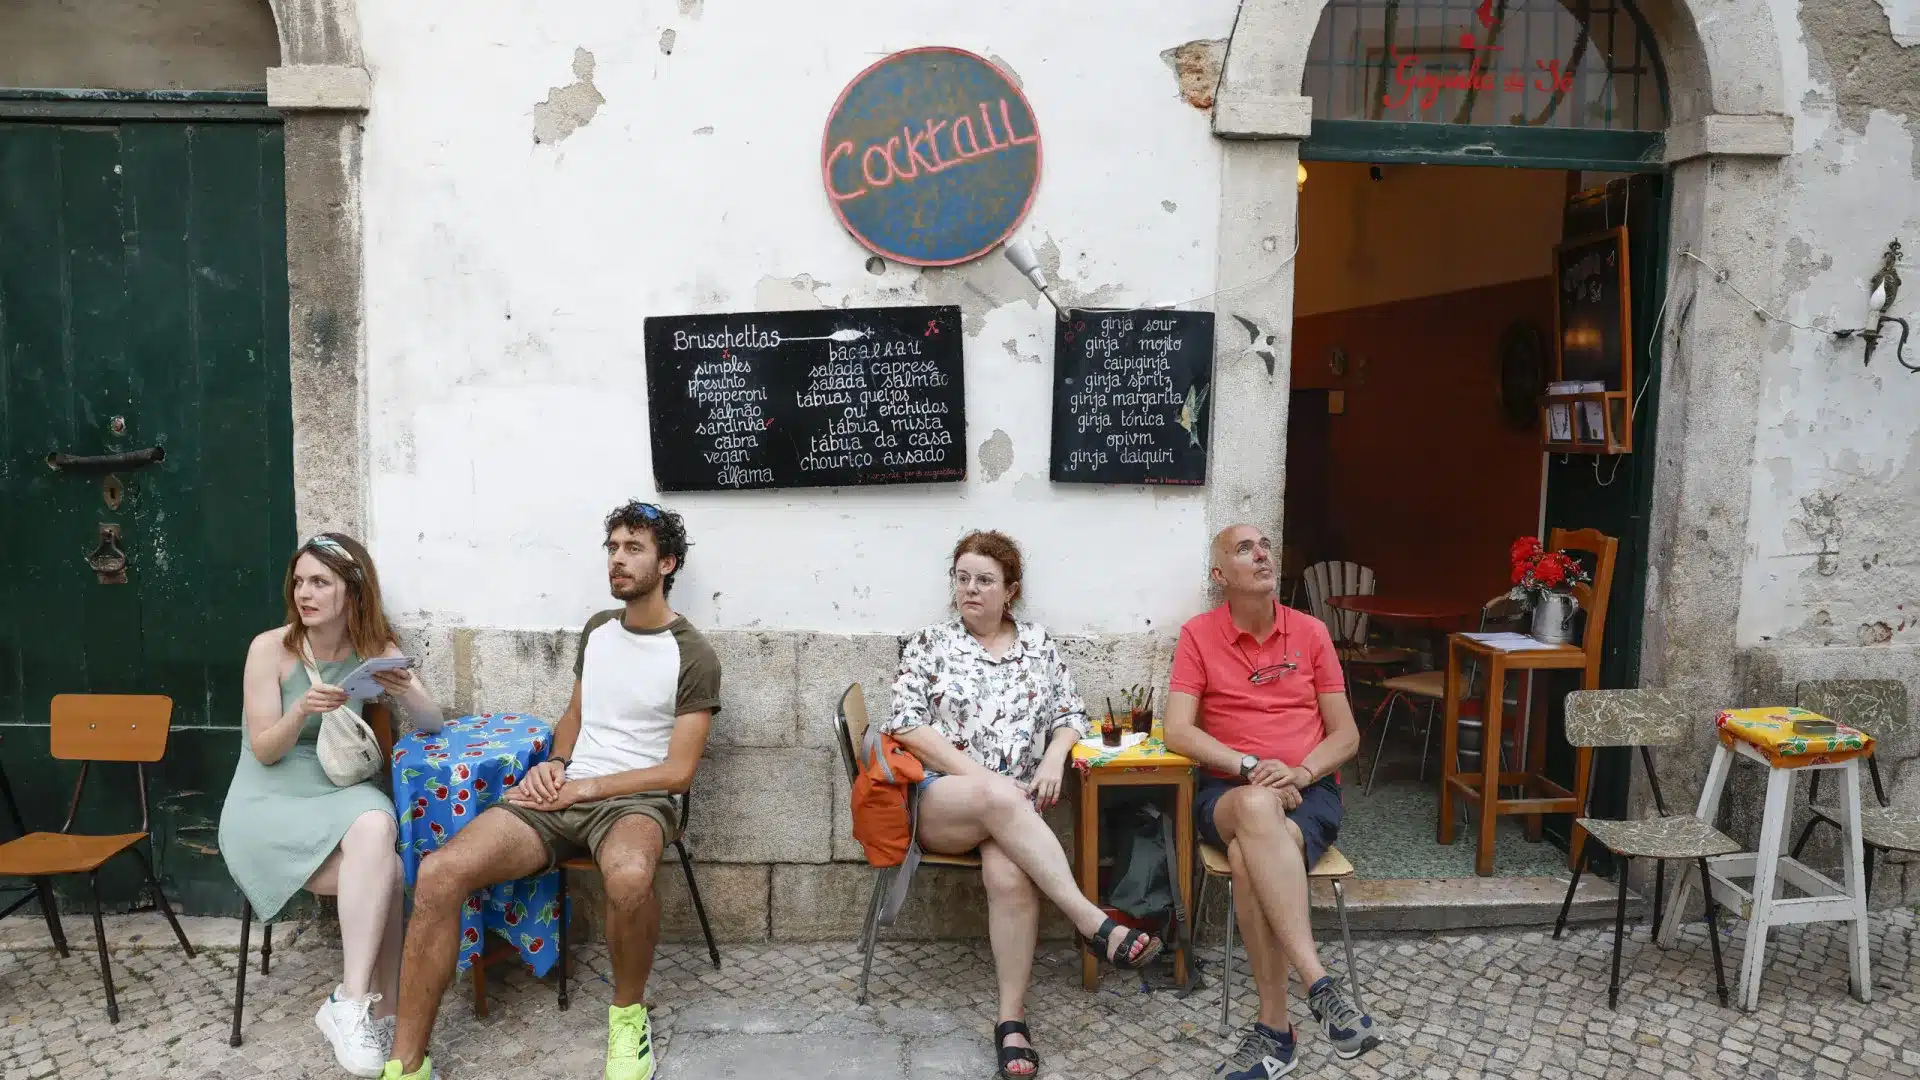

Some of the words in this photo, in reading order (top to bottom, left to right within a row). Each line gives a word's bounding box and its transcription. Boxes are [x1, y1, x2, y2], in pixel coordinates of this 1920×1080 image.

[673, 323, 781, 351] Bruschettas
[1101, 316, 1134, 338] ginja
[1142, 319, 1177, 332] sour
[829, 341, 922, 362] bacalhau
[1085, 337, 1120, 358] ginja
[1139, 334, 1183, 357] mojito
[695, 354, 752, 380] simples
[807, 361, 865, 378] salada
[871, 360, 940, 381] caprese
[1103, 355, 1171, 376] caipiginja
[688, 373, 746, 398] presunto
[807, 374, 868, 391] salada
[881, 371, 949, 388] salmão
[1084, 372, 1122, 394] ginja
[1127, 370, 1173, 393] spritz
[698, 386, 768, 408] pepperoni
[796, 390, 852, 408] tábuas
[860, 387, 910, 410] queijos
[844, 405, 867, 419] ou
[879, 397, 949, 417] enchidos
[1070, 391, 1108, 414] ginja
[1112, 388, 1184, 413] margarita
[707, 402, 762, 420] salmão
[1077, 412, 1112, 434] ginja
[1121, 409, 1165, 427] tónica
[695, 416, 767, 435] sardinha
[828, 418, 880, 436] tábua
[891, 415, 944, 432] mista
[714, 434, 759, 450] cabra
[811, 433, 863, 453] tábua
[874, 430, 898, 448] da
[908, 430, 953, 447] casa
[703, 449, 751, 471] vegan
[799, 451, 873, 471] chouriço
[883, 445, 945, 466] assado
[1069, 449, 1109, 471] ginja
[1120, 447, 1174, 470] daiquiri
[717, 465, 775, 488] alfama
